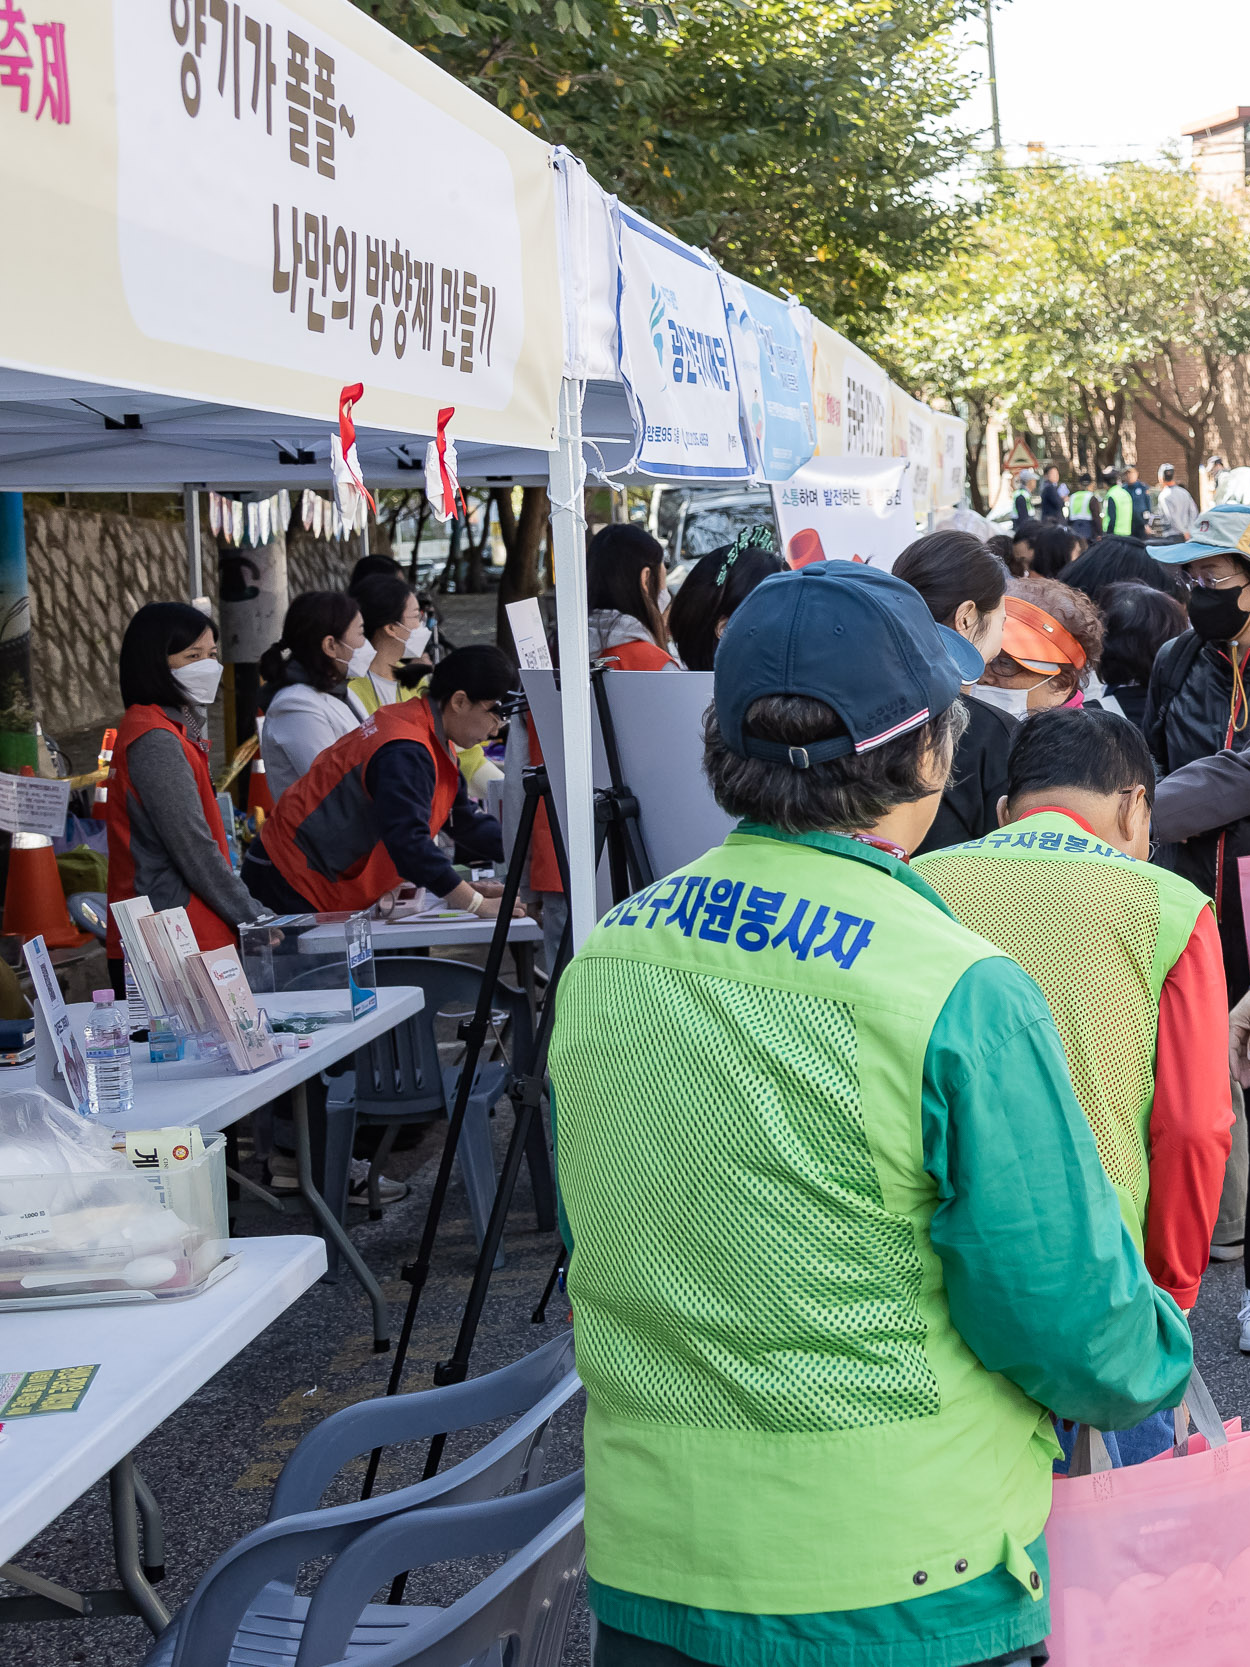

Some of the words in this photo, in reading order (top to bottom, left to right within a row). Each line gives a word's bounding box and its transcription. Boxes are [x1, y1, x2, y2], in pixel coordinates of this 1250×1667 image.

[0, 0, 70, 125] 축제
[272, 202, 358, 334] 나만의
[364, 237, 435, 361] 방향제
[440, 266, 498, 374] 만들기
[644, 425, 673, 443] 양로95
[782, 488, 819, 507] 소통하며
[823, 488, 861, 507] 발전하는
